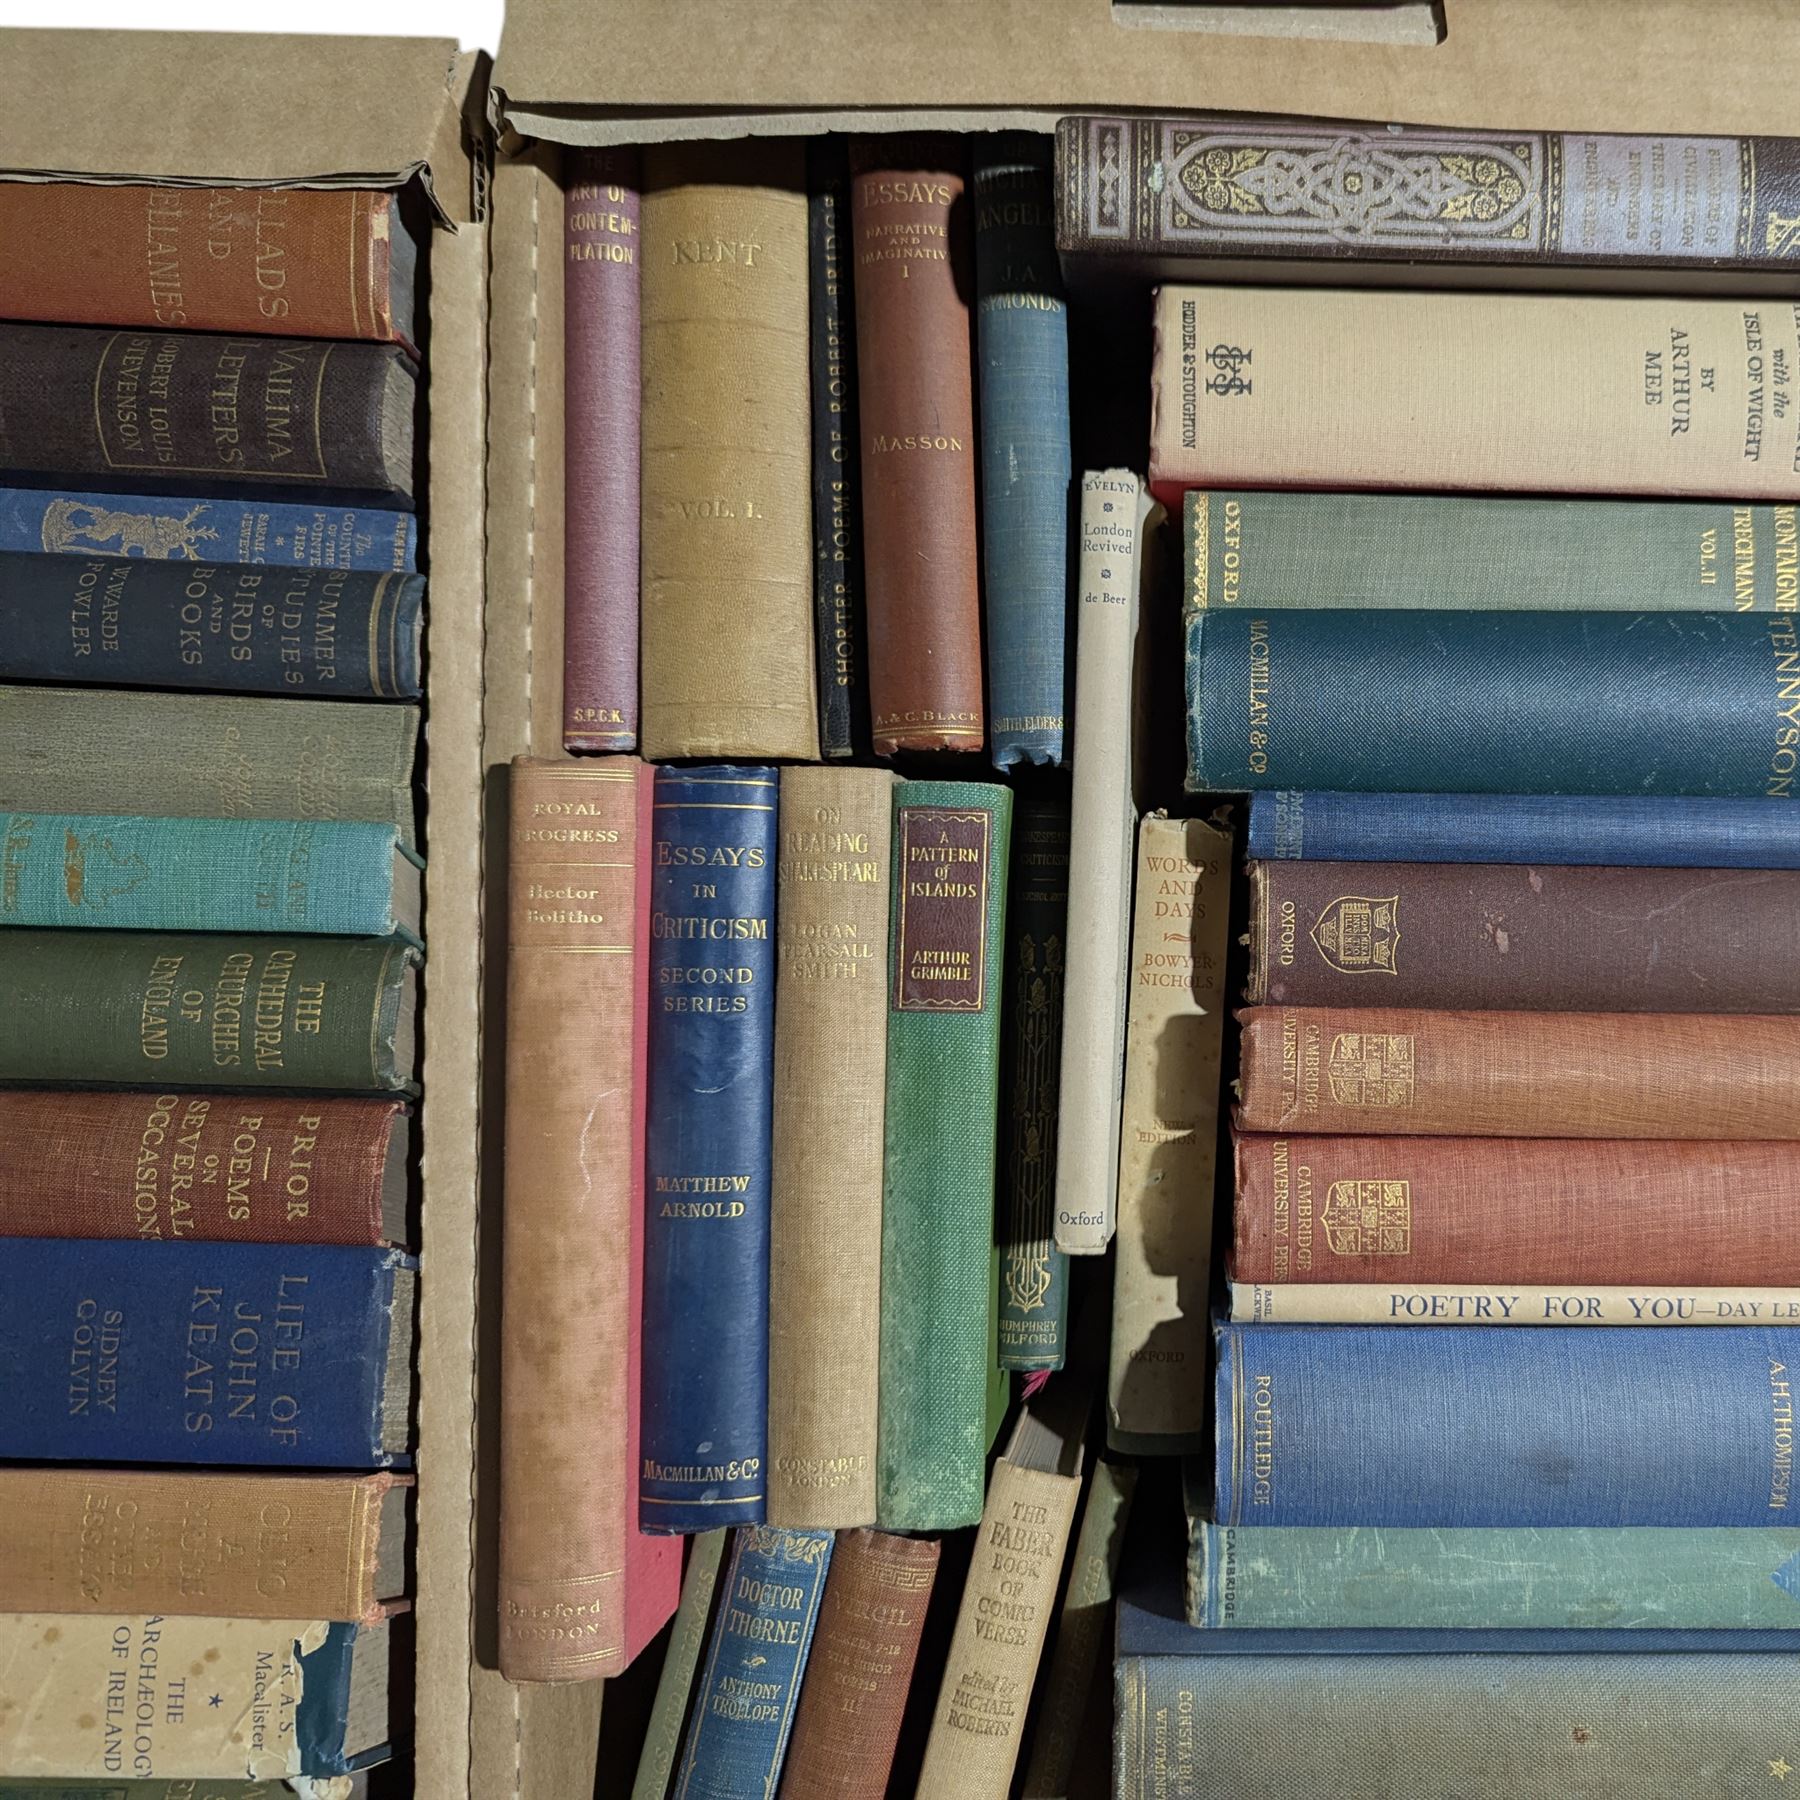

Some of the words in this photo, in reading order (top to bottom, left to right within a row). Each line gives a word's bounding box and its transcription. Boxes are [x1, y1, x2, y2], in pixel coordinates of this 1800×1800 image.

[571, 184, 598, 202] ART
[608, 184, 628, 203] OF
[863, 182, 951, 208] ESSAYS
[570, 212, 636, 235] CONTEM-
[570, 243, 633, 265] PLATION
[672, 240, 762, 267] KENT
[890, 236, 921, 246] AND
[980, 293, 1062, 314] SYMONDS
[1182, 300, 1196, 351] HODDER
[1743, 312, 1763, 351] ISLE
[151, 338, 185, 400] ROBERT
[1182, 354, 1196, 365] &
[1747, 356, 1763, 384] OF
[1773, 349, 1790, 386] with
[1645, 351, 1662, 405] MEE
[1671, 328, 1690, 437] ARTHUR
[1700, 368, 1714, 392] BY
[117, 338, 151, 453] STEVENSON
[210, 342, 261, 464] LETTERS
[266, 345, 312, 461] VAILIMA
[1182, 366, 1196, 449] STOUGHTON
[1773, 391, 1790, 419] the
[151, 406, 178, 462] LOUIS
[1744, 386, 1763, 462] WIGHT
[872, 435, 963, 454] MASSON
[1085, 480, 1135, 494] EVELYN
[677, 501, 735, 519] VOL.
[255, 513, 269, 551] SARAH
[294, 525, 307, 559] FIRS
[1083, 523, 1133, 538] London
[325, 539, 335, 565] THE
[1083, 539, 1133, 555] Revived
[1224, 501, 1240, 602] OXFORD
[1700, 528, 1716, 571] VOL.
[71, 562, 105, 657] FOWLER
[1085, 593, 1098, 604] de
[1102, 593, 1127, 605] Beer
[180, 567, 216, 665] BOOKS
[210, 595, 224, 634] AND
[230, 575, 262, 662] BIRDS
[262, 605, 275, 629] OF
[315, 571, 347, 680] SUMMER
[1250, 619, 1269, 726] MACMILLAN
[574, 708, 625, 724] S.P.C.K.
[890, 712, 902, 723] &
[904, 711, 920, 723] C.
[923, 710, 979, 722] BLACK
[1766, 616, 1800, 798] TENNYSON
[1250, 730, 1268, 748] &
[533, 802, 602, 816] ROYAL
[815, 806, 842, 824] ON
[786, 833, 869, 853] READING
[940, 831, 949, 844] A
[656, 842, 766, 868] ESSAYS
[911, 847, 979, 863] PATTERN
[1146, 857, 1219, 876] WORDS
[778, 862, 881, 882] SHAKESPEARE
[935, 863, 951, 880] of
[528, 884, 600, 901] Hector
[692, 884, 717, 898] IN
[911, 882, 977, 898] ISLANDS
[1158, 880, 1204, 897] AND
[527, 911, 603, 925] Bolitho
[1154, 901, 1207, 919] DAYS
[652, 912, 769, 941] CRITICISM
[793, 924, 857, 938] LOGAN
[1281, 902, 1295, 965] OXFORD
[783, 943, 874, 958] PEARSALL
[911, 951, 970, 965] ARTHUR
[660, 967, 753, 984] SECOND
[793, 962, 857, 978] SMITH
[911, 967, 972, 981] GRIMBLE
[1139, 973, 1215, 989] NICHOLS
[142, 956, 184, 1059] ENGLAND
[180, 990, 204, 1023] OF
[213, 952, 254, 1067] CHURCHES
[255, 950, 297, 1071] CATHEDRAL
[296, 981, 326, 1034] THE
[664, 996, 747, 1012] SERIES
[1138, 1132, 1196, 1145] EDITION
[171, 1100, 210, 1235] SEVERAL
[203, 1154, 219, 1184] ON
[228, 1116, 263, 1221] POEMS
[287, 1115, 321, 1221] PRIOR
[656, 1175, 751, 1193] MATTHEW
[1273, 1141, 1289, 1237] UNIVERSITY
[660, 1202, 745, 1218] ARNOLD
[1059, 1211, 1105, 1225] Oxford
[1297, 1166, 1312, 1271] CAMBRIDGE
[1263, 1290, 1273, 1317] BASIL
[1389, 1294, 1520, 1318] POETRY
[1542, 1296, 1604, 1318] FOR
[272, 1275, 309, 1371] LIFE
[69, 1300, 97, 1416] COLVIN
[99, 1310, 123, 1413] SIDNEY
[185, 1286, 223, 1433] KEATS
[228, 1302, 262, 1421] JOHN
[271, 1395, 297, 1446] OF
[1254, 1375, 1272, 1505] ROUTLEDGE
[643, 1459, 725, 1482] MACMILLAN
[775, 1456, 868, 1474] CONSTABLE
[1012, 1500, 1048, 1526] THE
[989, 1521, 1056, 1558] FABER
[992, 1552, 1040, 1579] BOOK
[1224, 1529, 1236, 1620] CAMBRIDGE
[738, 1576, 804, 1611] DOCTOR
[1000, 1580, 1024, 1598] OF
[978, 1597, 1036, 1622] COMIC
[728, 1609, 801, 1644] THORNE
[974, 1618, 1028, 1646] VERSE
[112, 1626, 131, 1657] OF
[718, 1675, 781, 1698] ANTHONY
[166, 1678, 186, 1724] THE
[252, 1650, 274, 1751] Macalister
[279, 1695, 295, 1718] A.
[712, 1694, 780, 1722] TROLLOPE
[952, 1690, 1016, 1717] MICHAEL
[104, 1670, 128, 1772] IRELAND
[277, 1720, 293, 1739] S.
[947, 1709, 1011, 1737] ROBERTS
